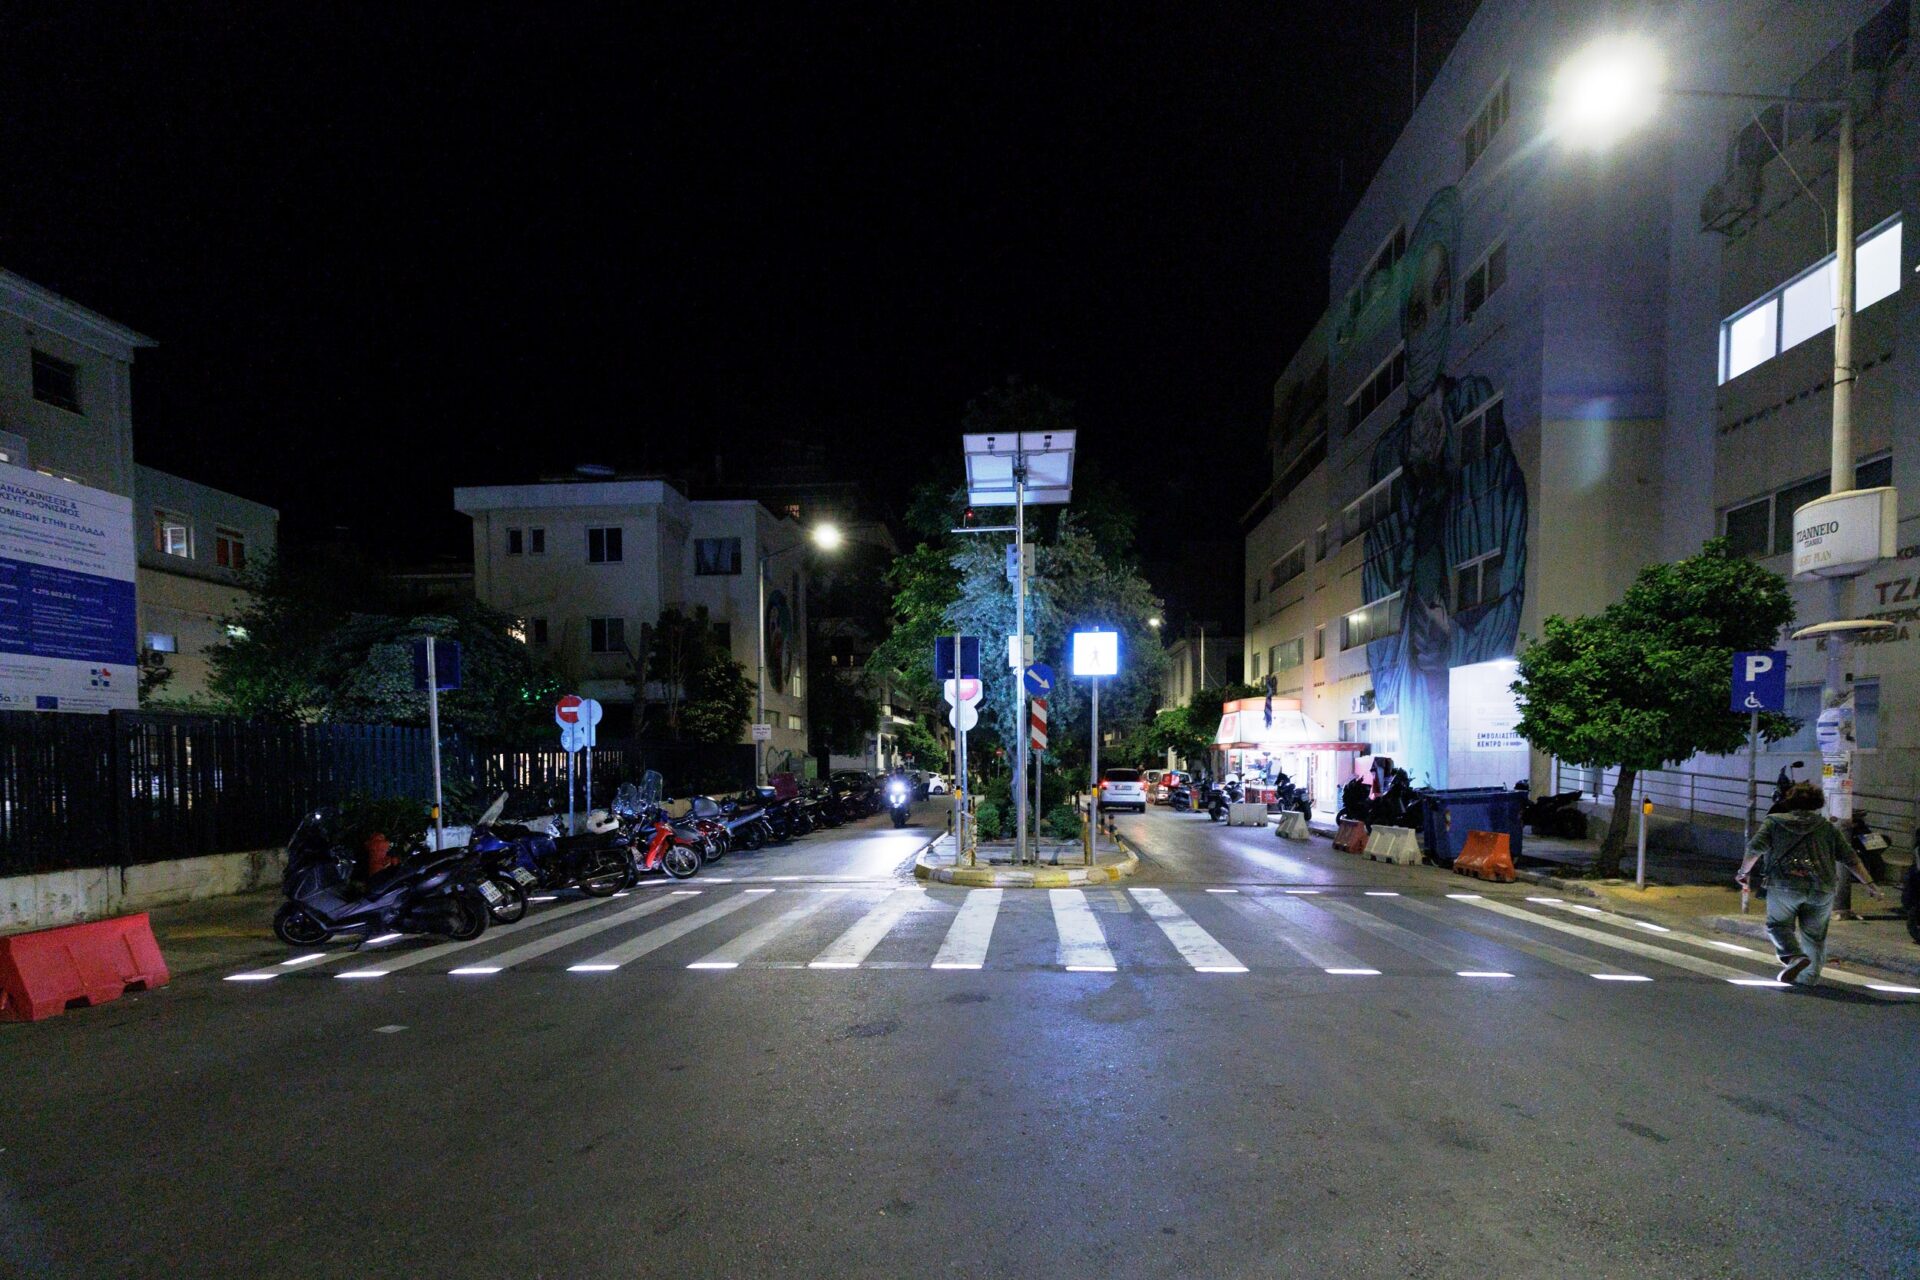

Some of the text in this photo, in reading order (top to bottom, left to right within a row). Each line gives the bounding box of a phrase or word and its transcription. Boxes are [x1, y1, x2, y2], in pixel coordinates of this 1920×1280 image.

[0, 483, 67, 507] ΑΝΑΚΑΙΝΙΣΕΙΣ
[42, 516, 67, 529] ΣΤΗΝ
[69, 523, 106, 538] ΕΛΛΑΔΑ
[1745, 655, 1772, 682] P
